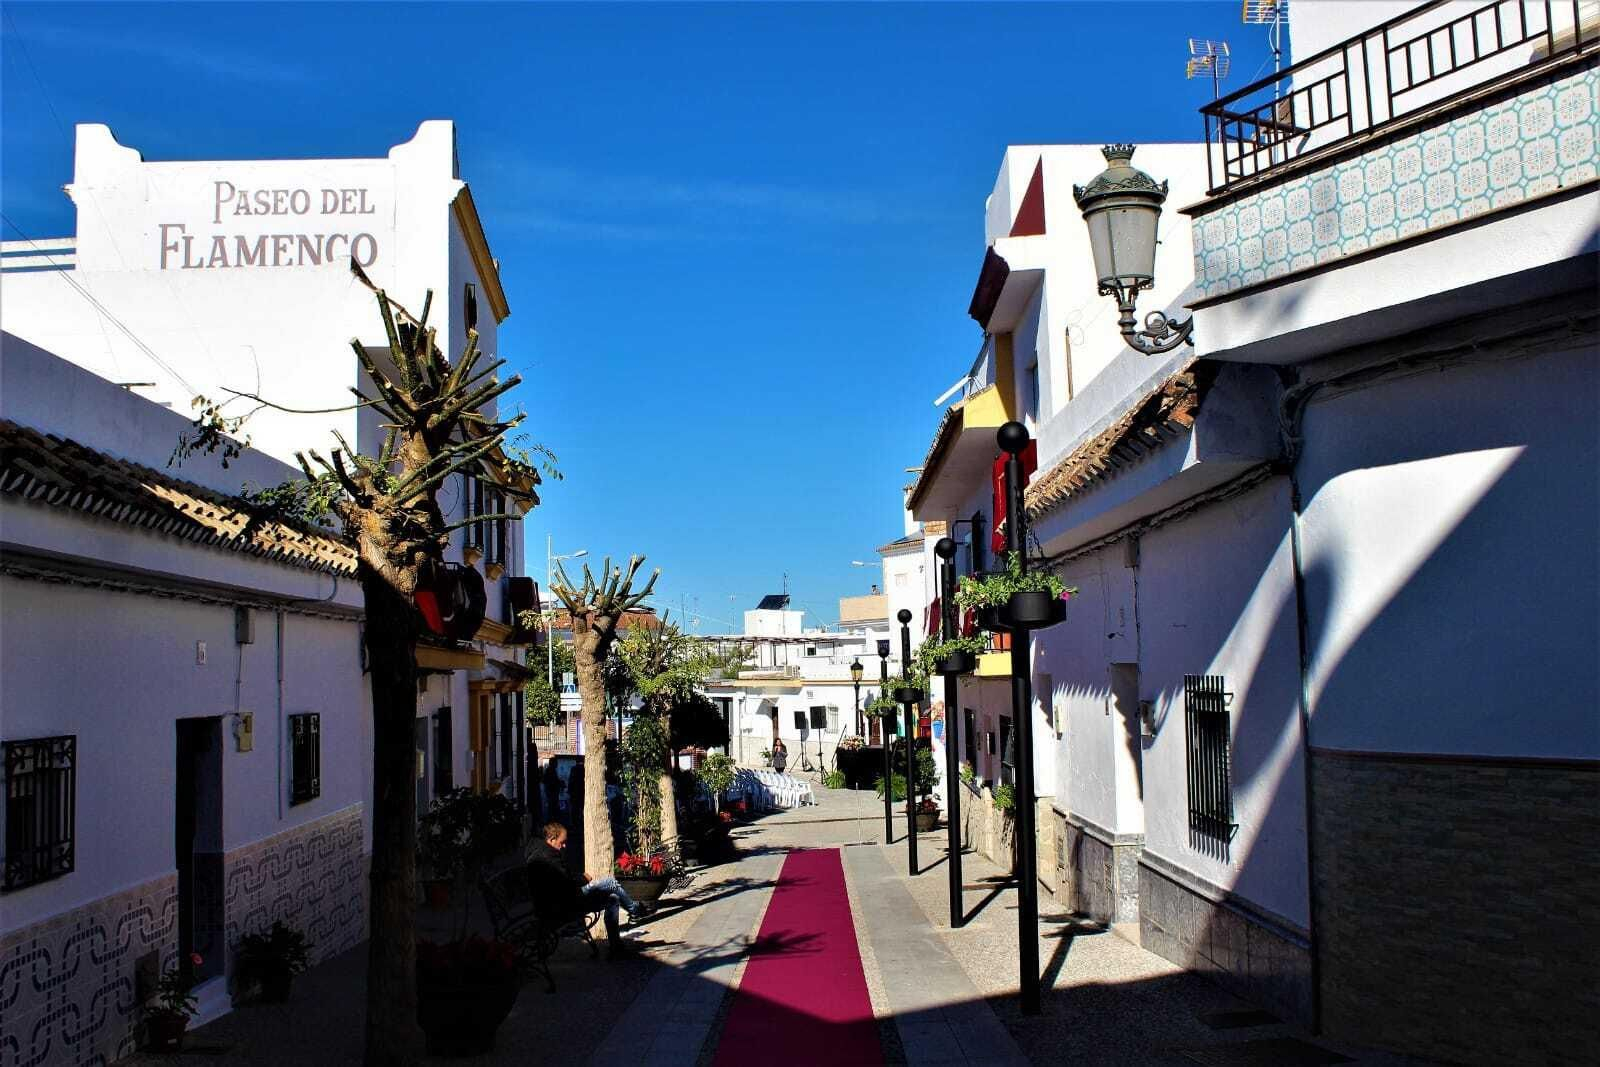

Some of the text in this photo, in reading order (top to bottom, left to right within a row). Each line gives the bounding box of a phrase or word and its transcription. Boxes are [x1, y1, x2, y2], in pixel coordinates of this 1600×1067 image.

[213, 181, 375, 224] PASEO DEL
[159, 224, 378, 270] FLAMENCO
